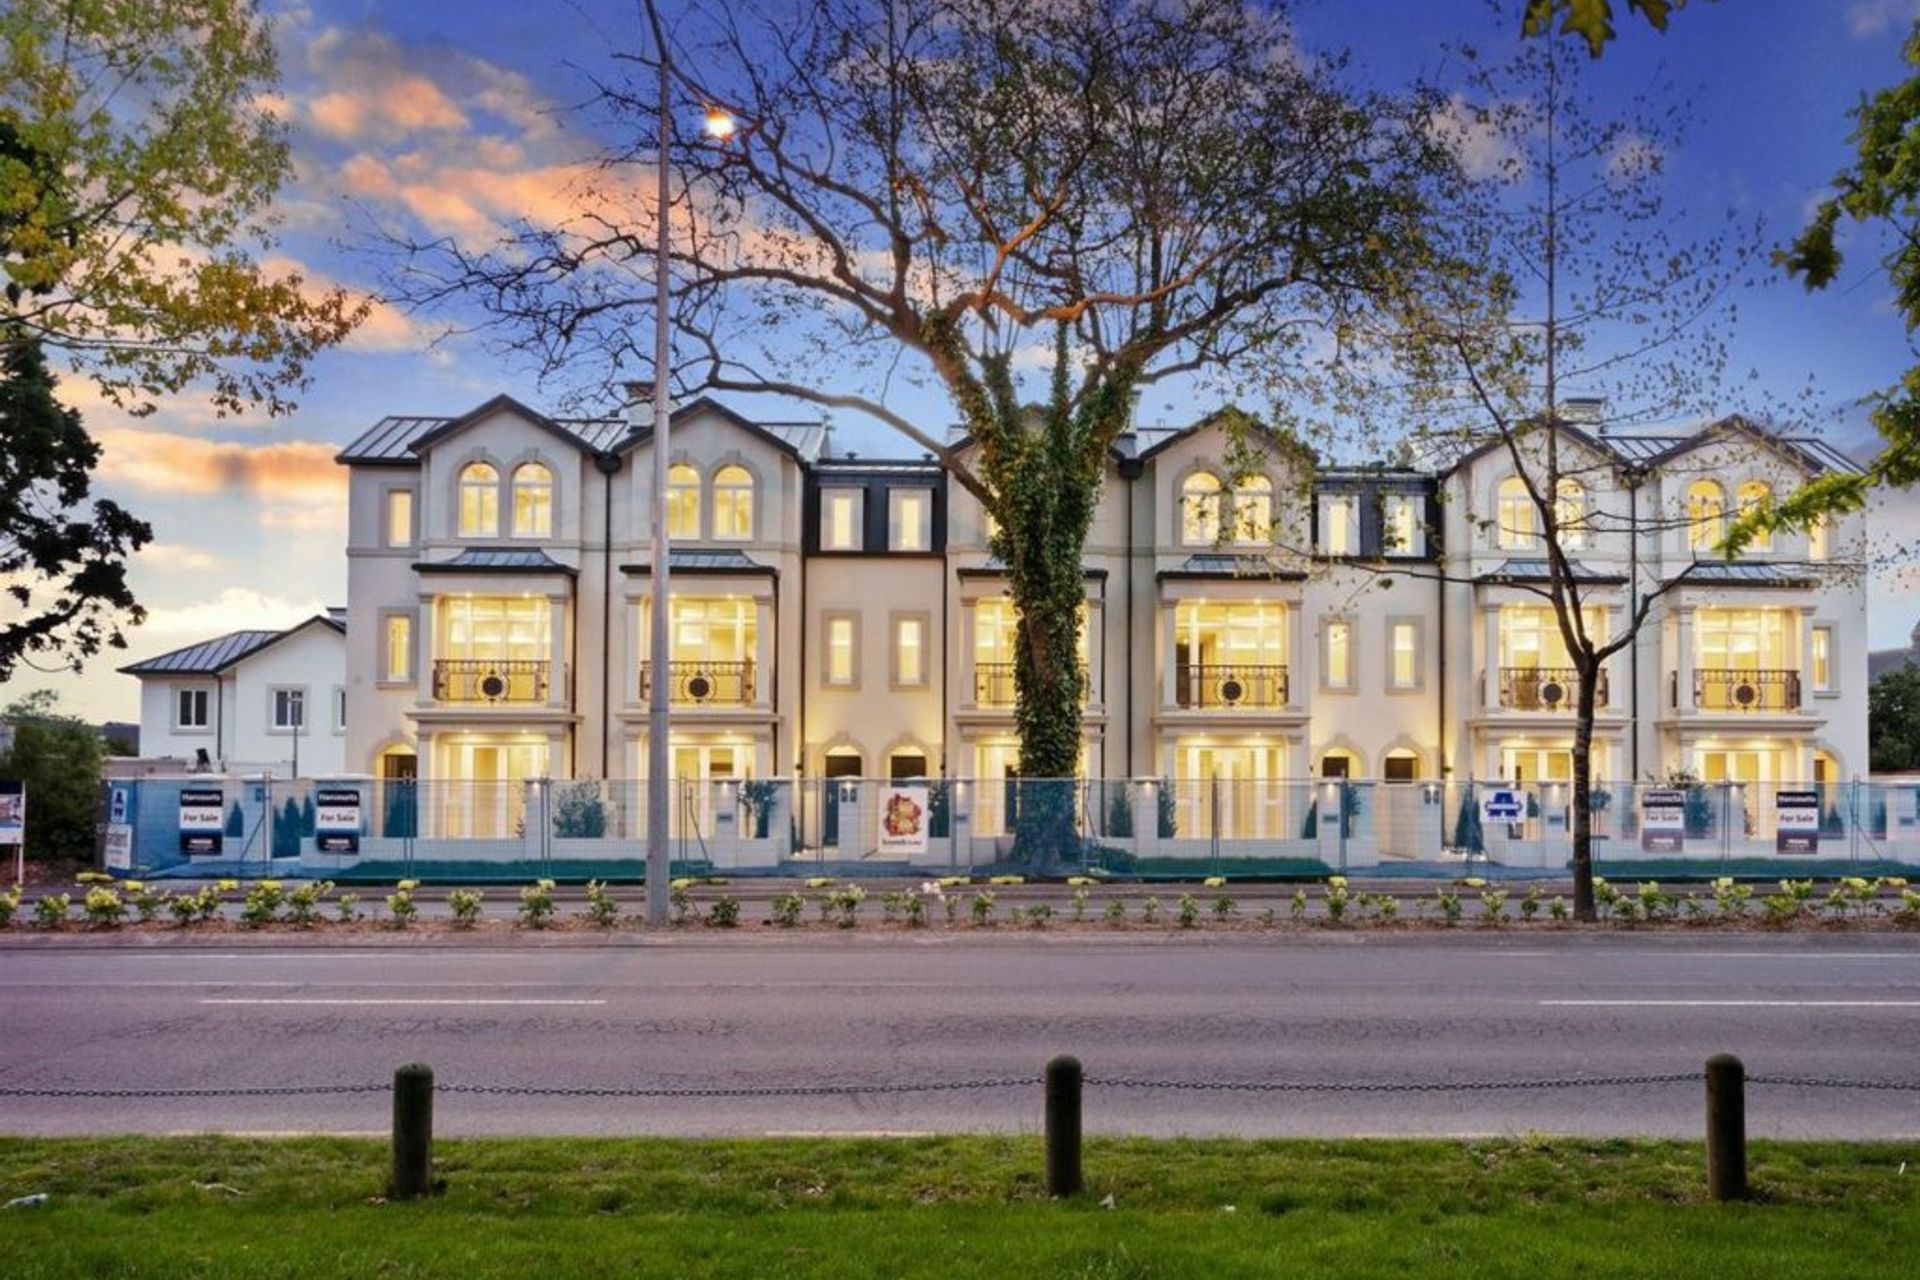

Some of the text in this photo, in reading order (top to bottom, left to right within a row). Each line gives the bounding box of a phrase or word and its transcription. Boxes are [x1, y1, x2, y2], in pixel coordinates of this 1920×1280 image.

[183, 813, 219, 822] For Sale
[320, 813, 355, 822] For Sale
[1780, 813, 1814, 823] For Sale
